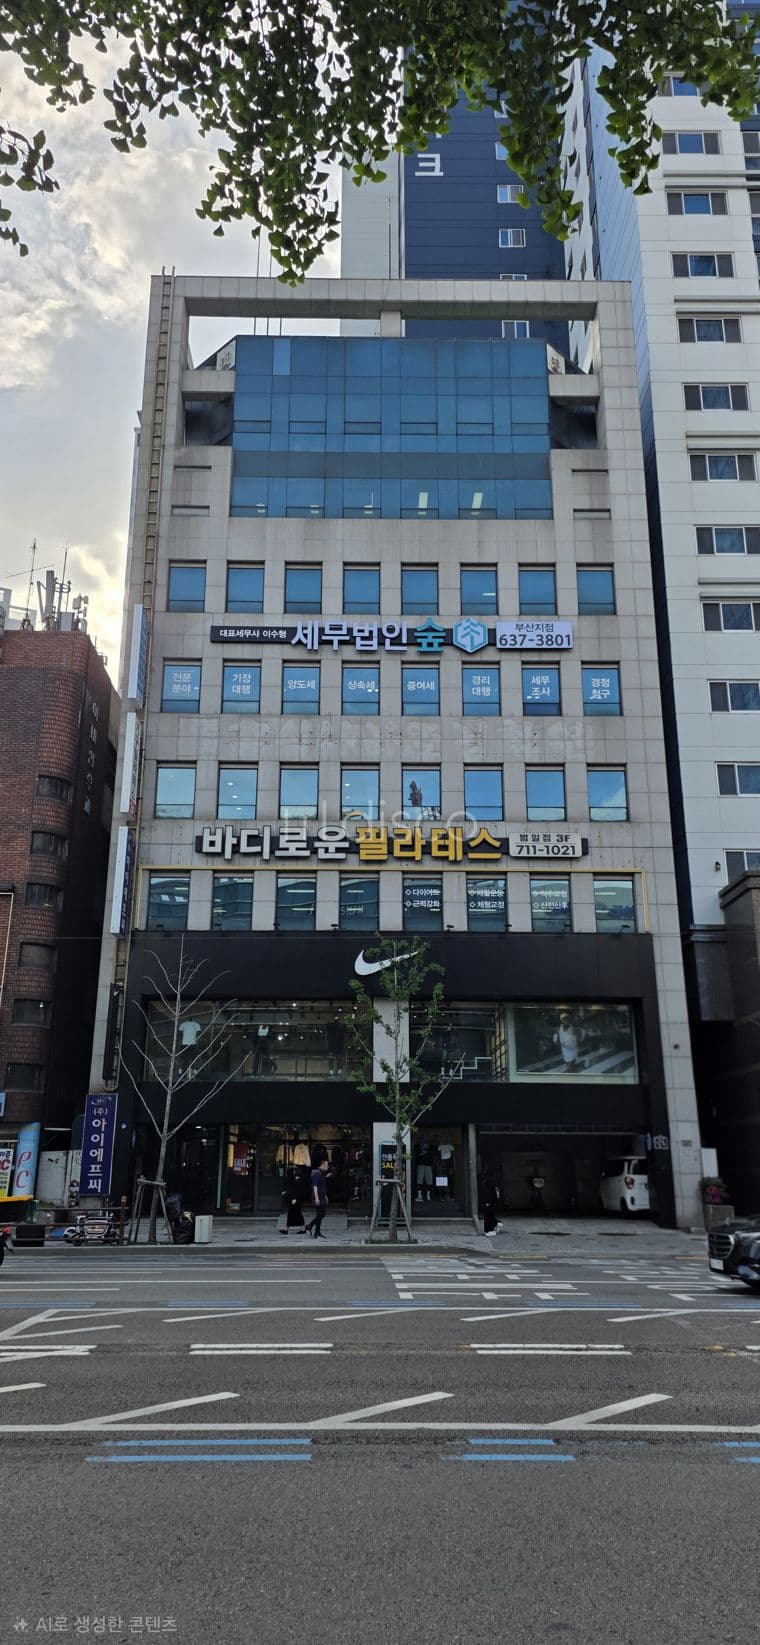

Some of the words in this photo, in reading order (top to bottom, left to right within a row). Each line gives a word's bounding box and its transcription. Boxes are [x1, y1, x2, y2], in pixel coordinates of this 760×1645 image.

[515, 622, 554, 633] 부산지점
[219, 629, 260, 638] 대표세무사
[262, 629, 287, 639] 이수형
[291, 619, 407, 652] 세무법인
[414, 617, 446, 652] 숲
[499, 634, 571, 647] 637-3801
[232, 673, 252, 684] 기장
[471, 675, 490, 685] 경리
[530, 675, 550, 686] 세무
[591, 677, 611, 688] 경정
[231, 684, 251, 695] 대행
[287, 679, 316, 690] 양도세
[347, 680, 376, 691] 상속세
[407, 680, 435, 691] 증여세
[471, 686, 491, 697] 대행
[531, 686, 551, 697] 조사
[556, 833, 571, 843] 3F
[515, 844, 577, 856] 711-1021
[87, 1118, 107, 1193] 아이에프씨
